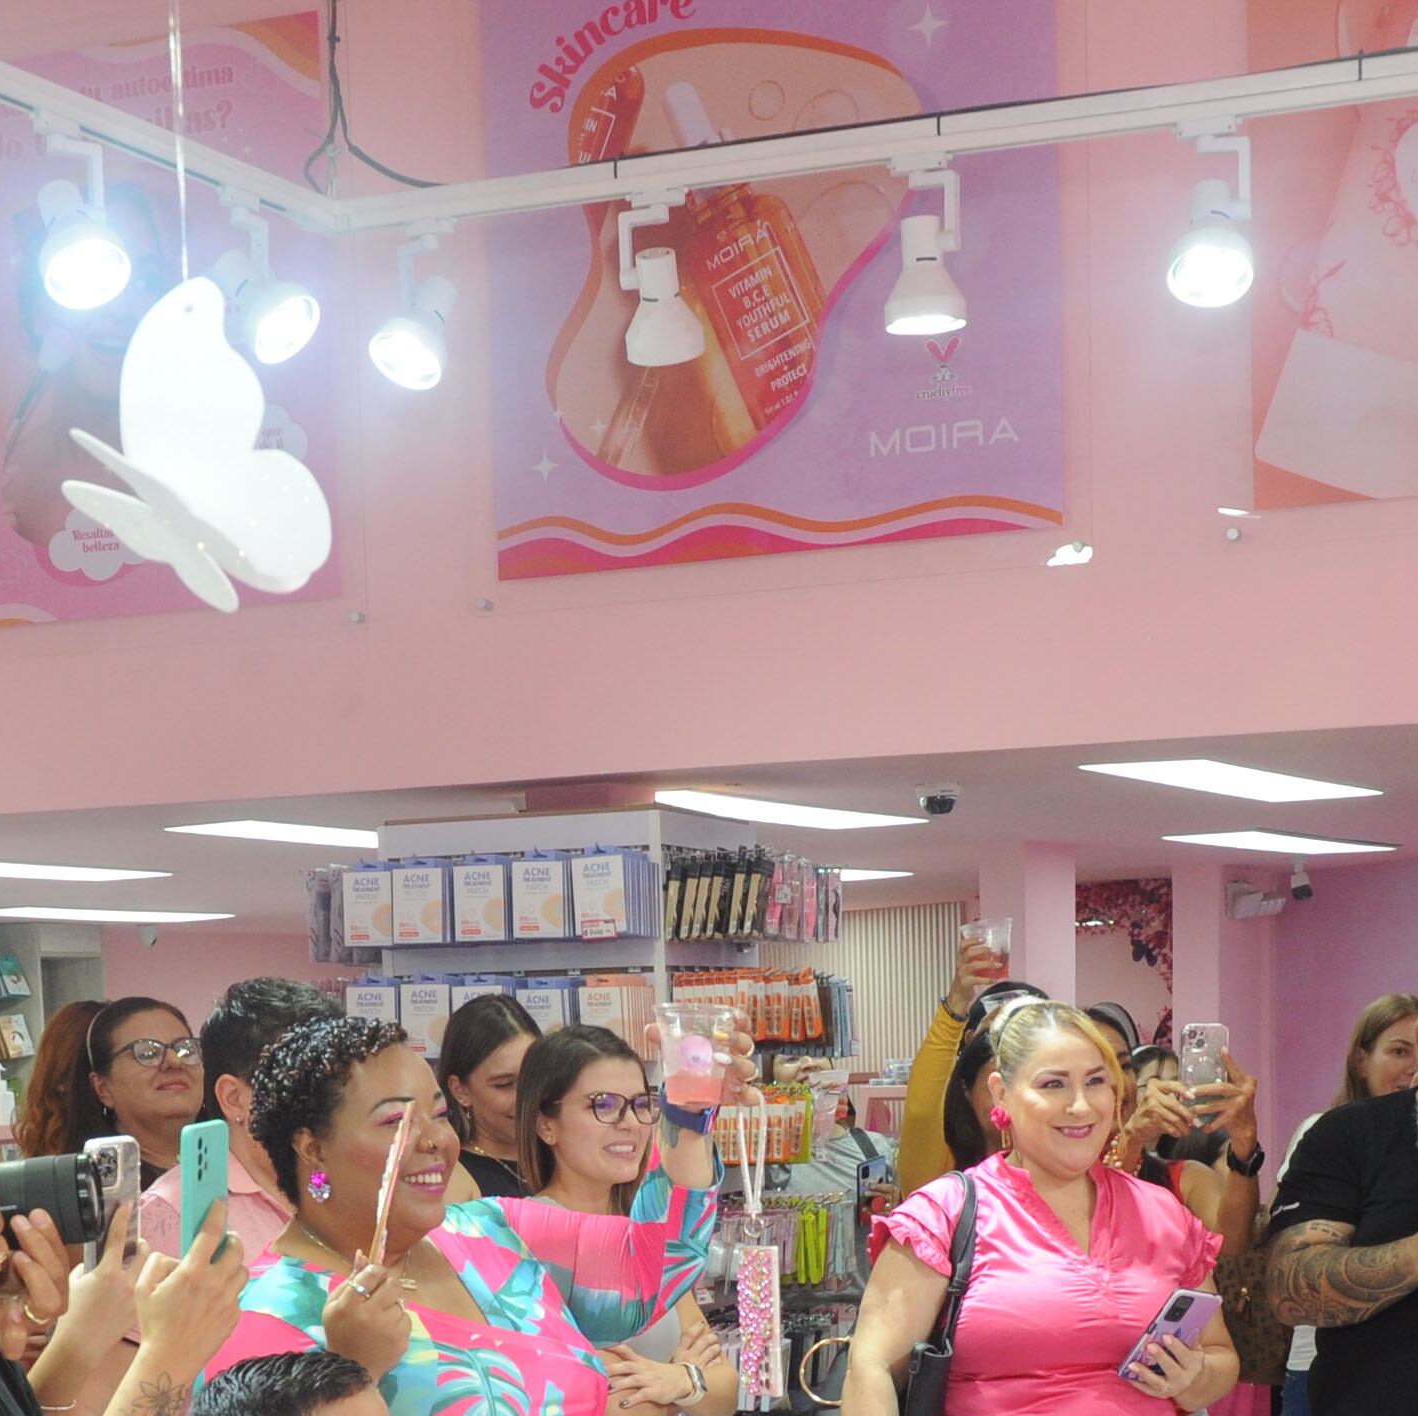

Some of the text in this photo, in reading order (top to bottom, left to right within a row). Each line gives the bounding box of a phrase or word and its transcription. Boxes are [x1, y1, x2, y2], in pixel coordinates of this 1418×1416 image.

[112, 65, 234, 101] autoetima
[706, 226, 771, 271] MOIRA
[729, 264, 774, 299] VITAMIN
[736, 292, 794, 331] YOUTHFUL
[747, 310, 792, 343] SERUM
[770, 364, 808, 392] PROTECT
[869, 415, 1021, 458] MOIRA
[523, 867, 550, 876] ACNE
[583, 861, 611, 873] ACNE
[403, 873, 430, 883] ACNE
[464, 871, 492, 881] ACNE
[353, 877, 380, 887] ACNE
[357, 992, 382, 1002] ACNE
[410, 989, 438, 999] ACNE
[525, 994, 551, 1004] ACNE
[587, 992, 612, 1002] ACNE
